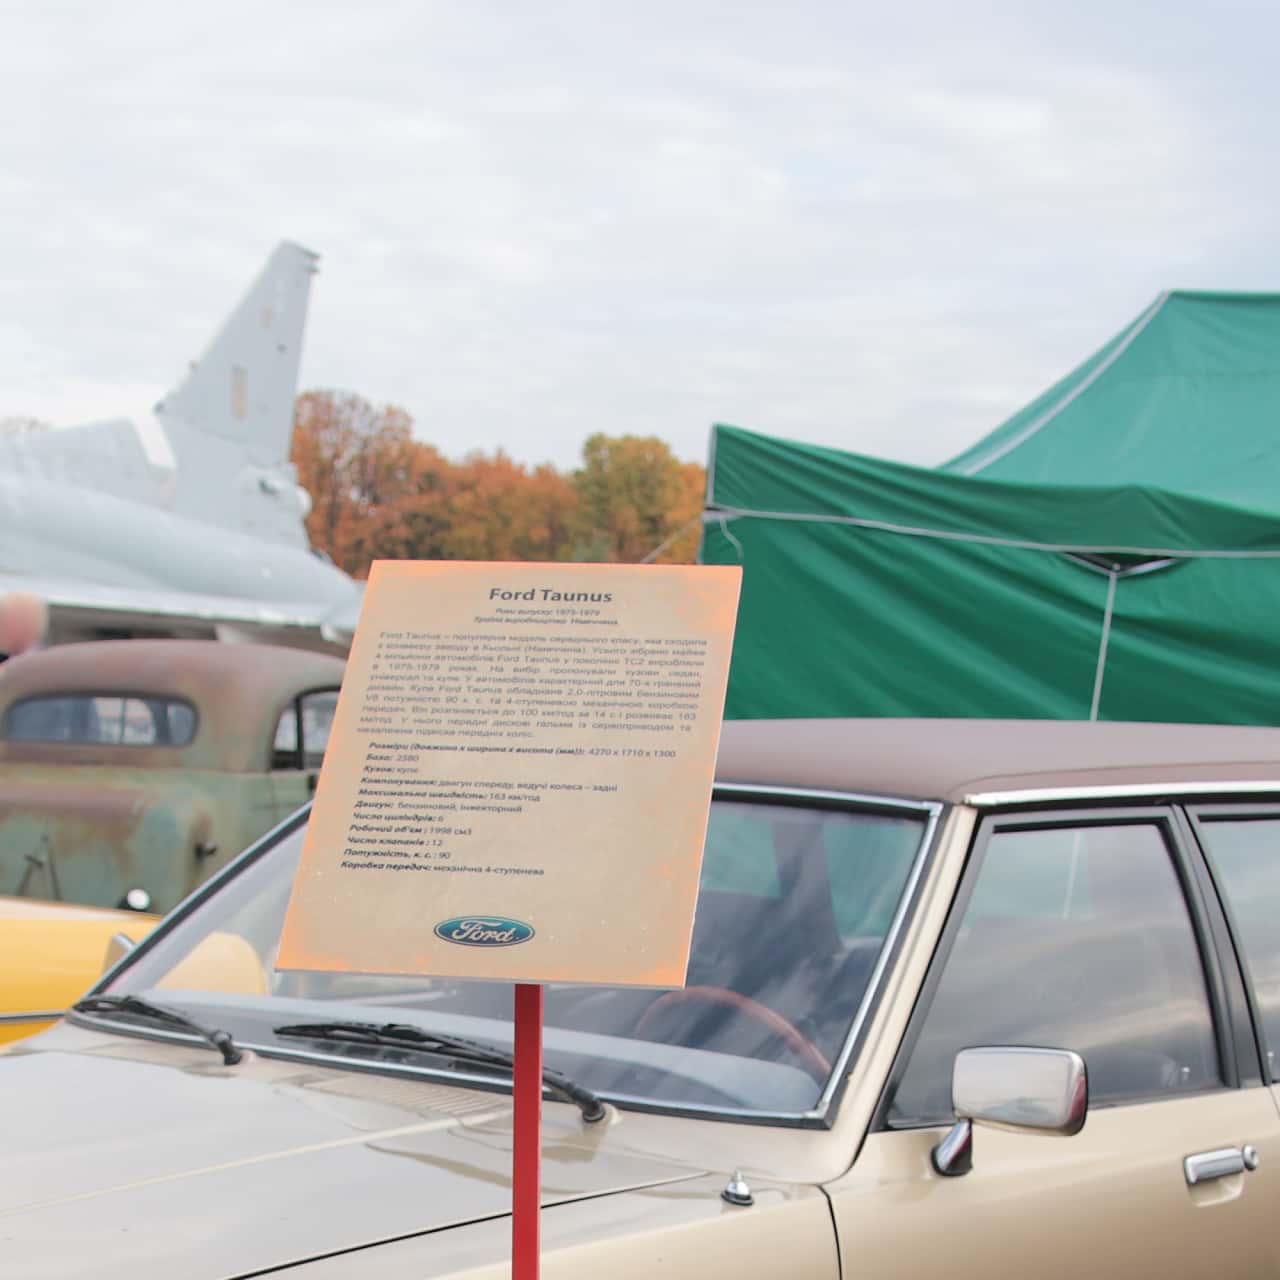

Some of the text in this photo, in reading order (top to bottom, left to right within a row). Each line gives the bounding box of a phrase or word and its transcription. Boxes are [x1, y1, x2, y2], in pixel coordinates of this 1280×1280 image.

[489, 588, 613, 601] Ford Taunus
[341, 861, 384, 869] Коробка
[485, 867, 544, 875] 4-ступенева
[452, 920, 516, 941] Ford
